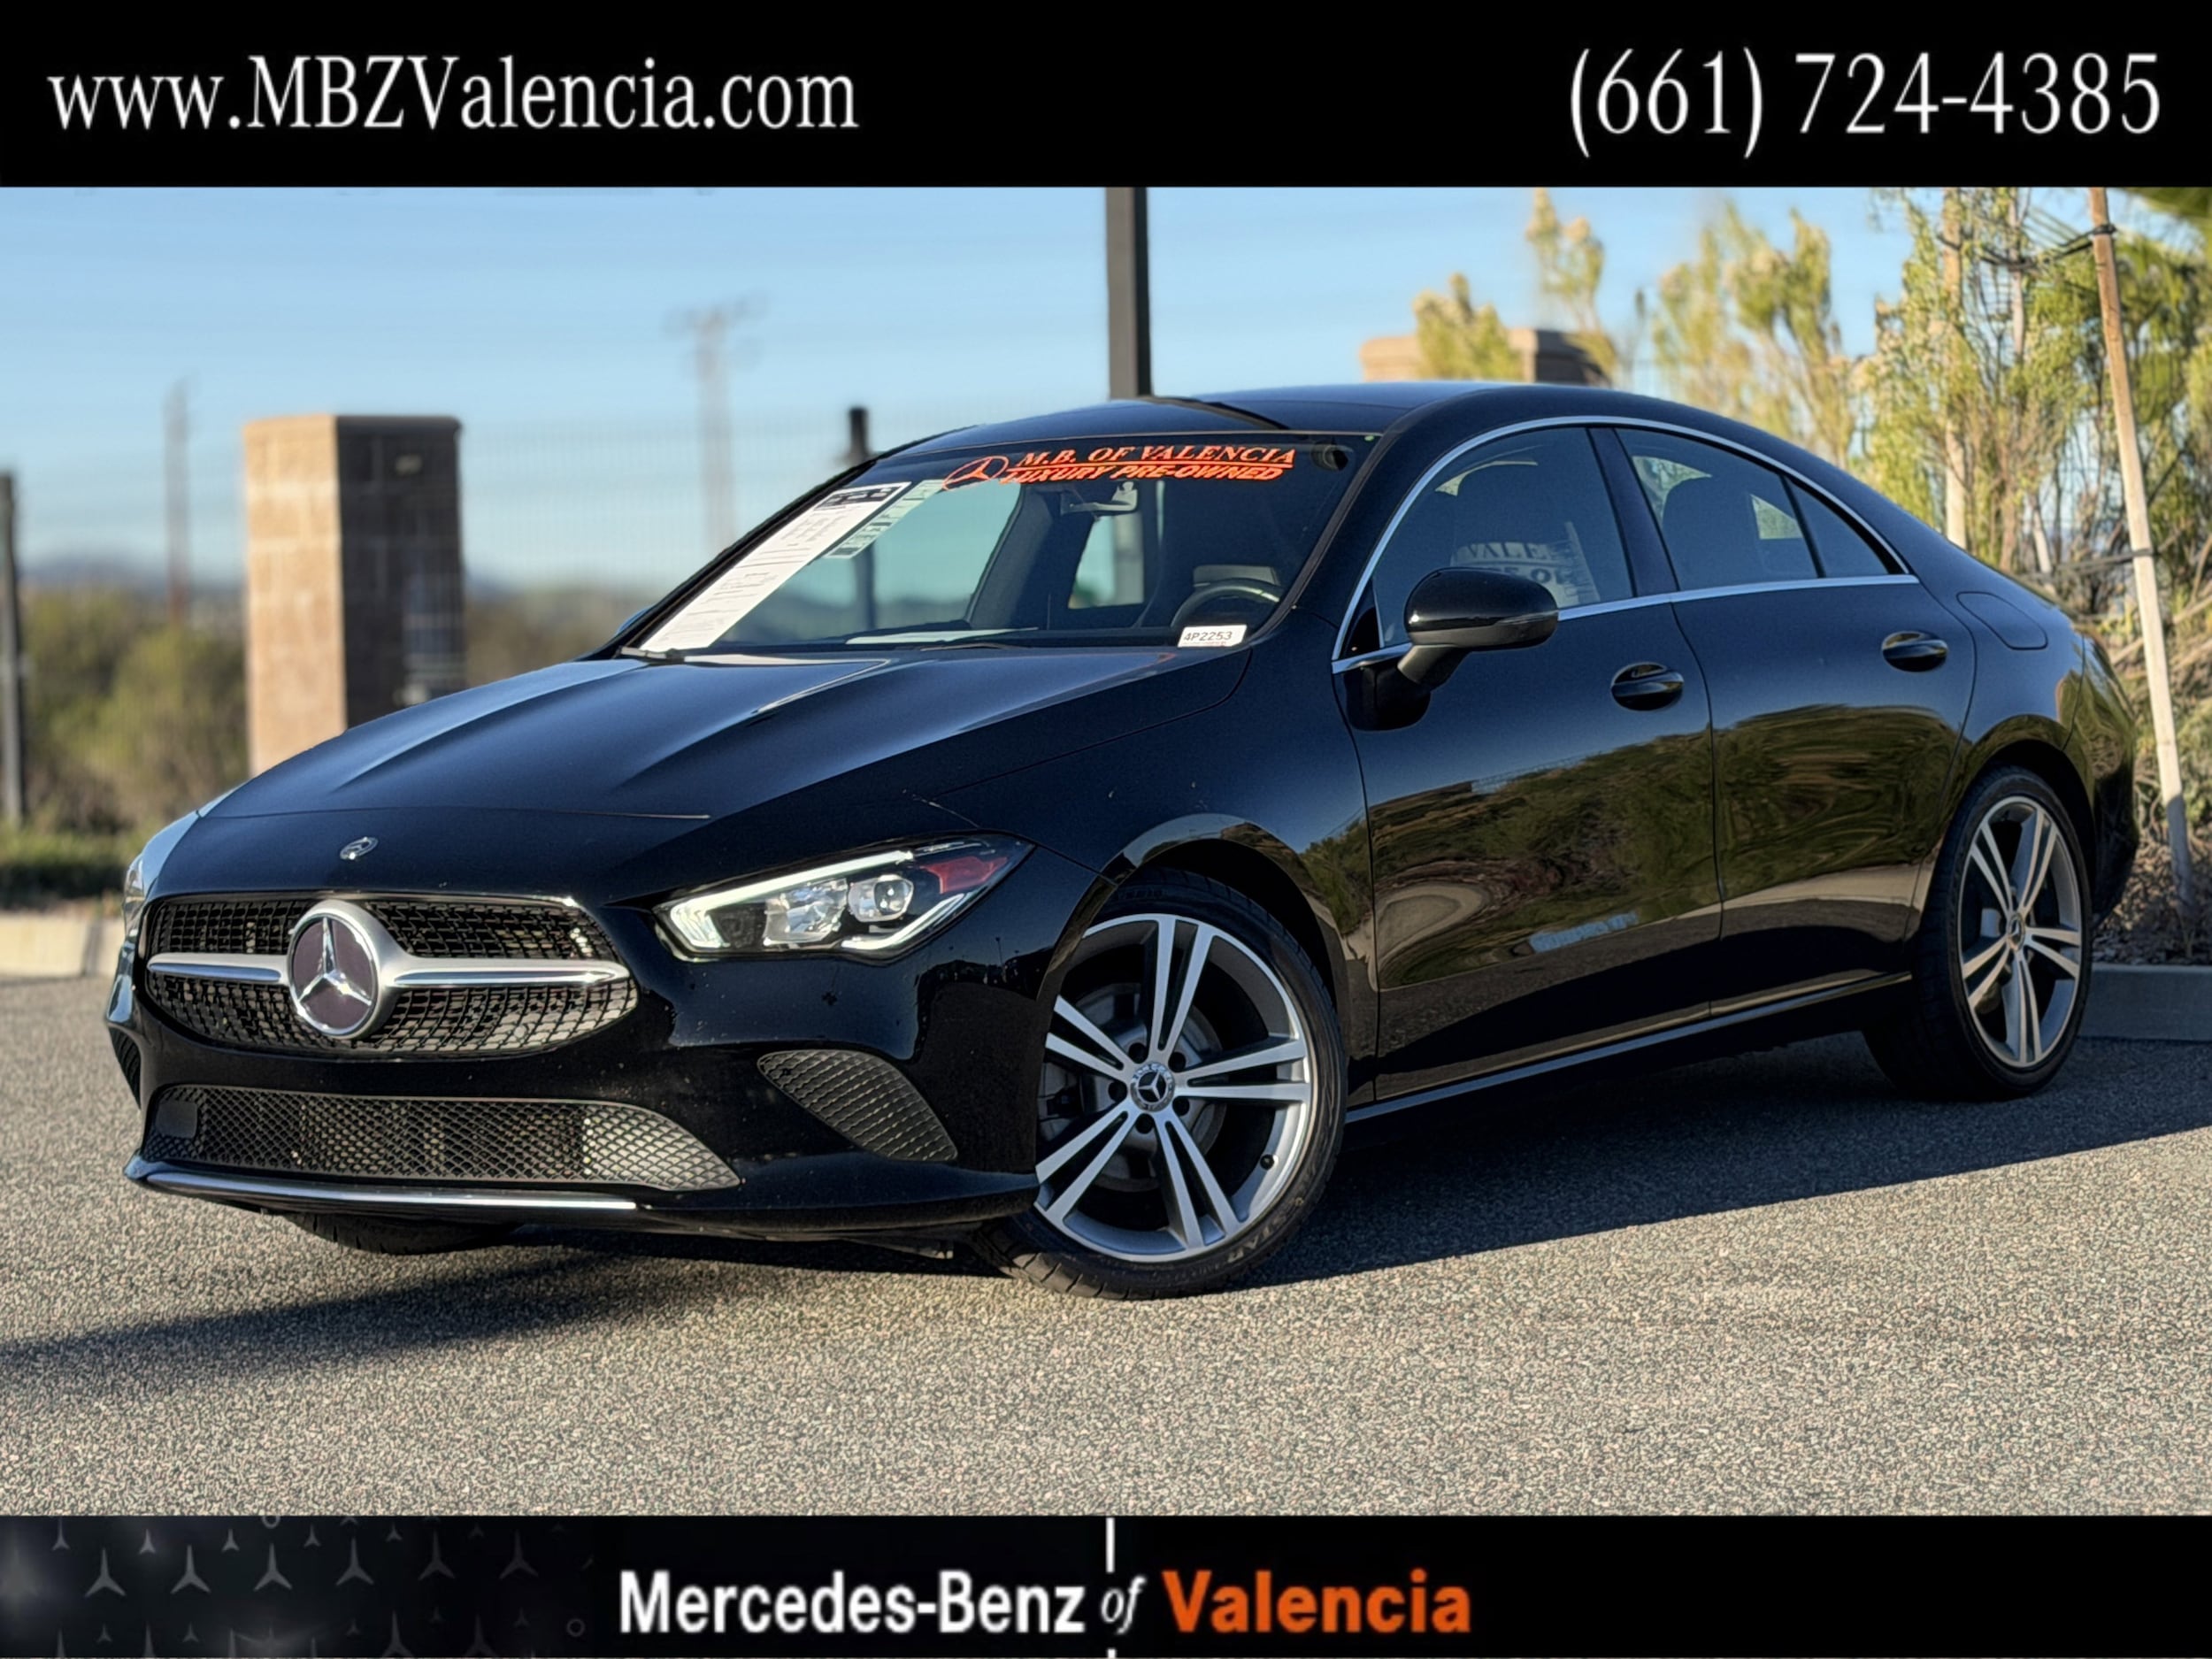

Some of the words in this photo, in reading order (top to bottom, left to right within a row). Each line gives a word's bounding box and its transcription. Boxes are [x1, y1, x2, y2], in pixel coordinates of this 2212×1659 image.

[1018, 449, 1077, 466] M.B.
[1087, 447, 1136, 462] OF
[1141, 445, 1296, 464] VALENCIA
[998, 464, 1117, 484] LUXURY
[1110, 464, 1285, 480] PRE-OWNED
[1183, 631, 1233, 641] 4P2253
